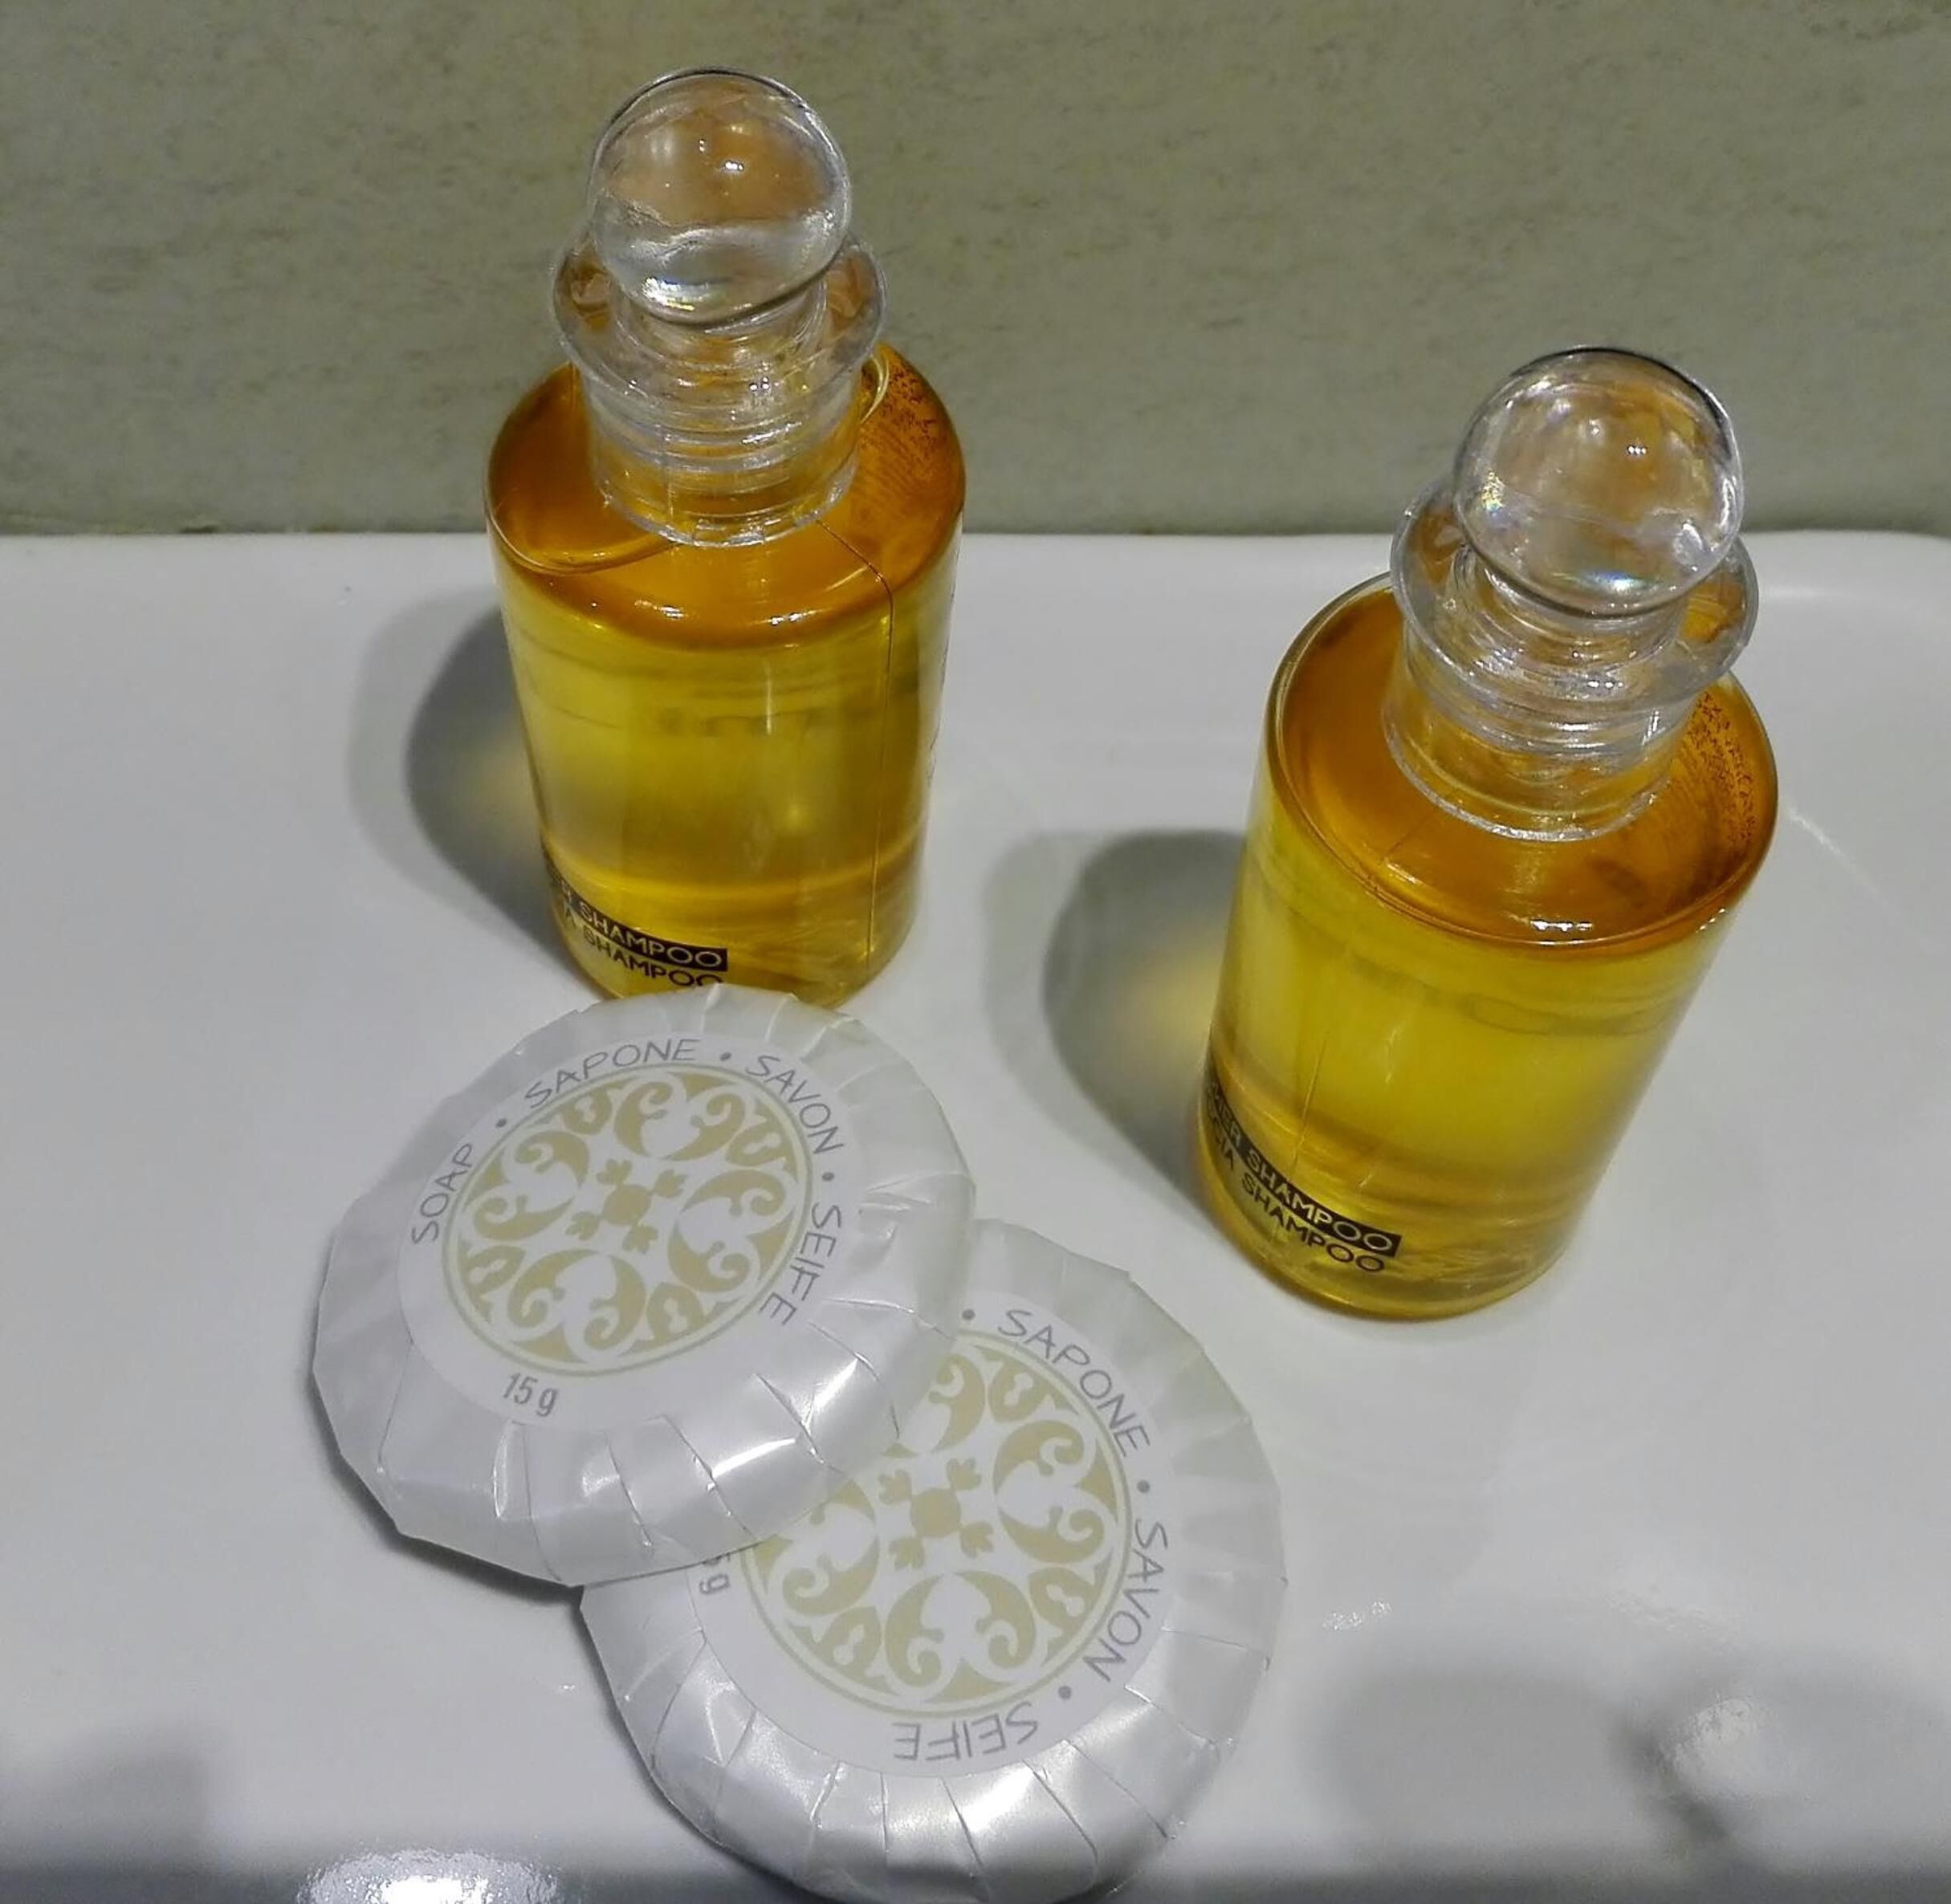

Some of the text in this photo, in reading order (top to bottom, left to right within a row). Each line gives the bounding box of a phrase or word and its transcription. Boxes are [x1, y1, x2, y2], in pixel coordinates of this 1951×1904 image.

[579, 901, 721, 967] SHAMPOO
[583, 926, 723, 987] SHAMPOO
[410, 1038, 845, 1325] SOAP SAPONE SAVON SEIFE
[1241, 1173, 1385, 1272] SHAMPOO
[1246, 1149, 1393, 1251] SHAMPOO
[891, 1308, 1169, 1761] SAPONE SAVON SEIFE
